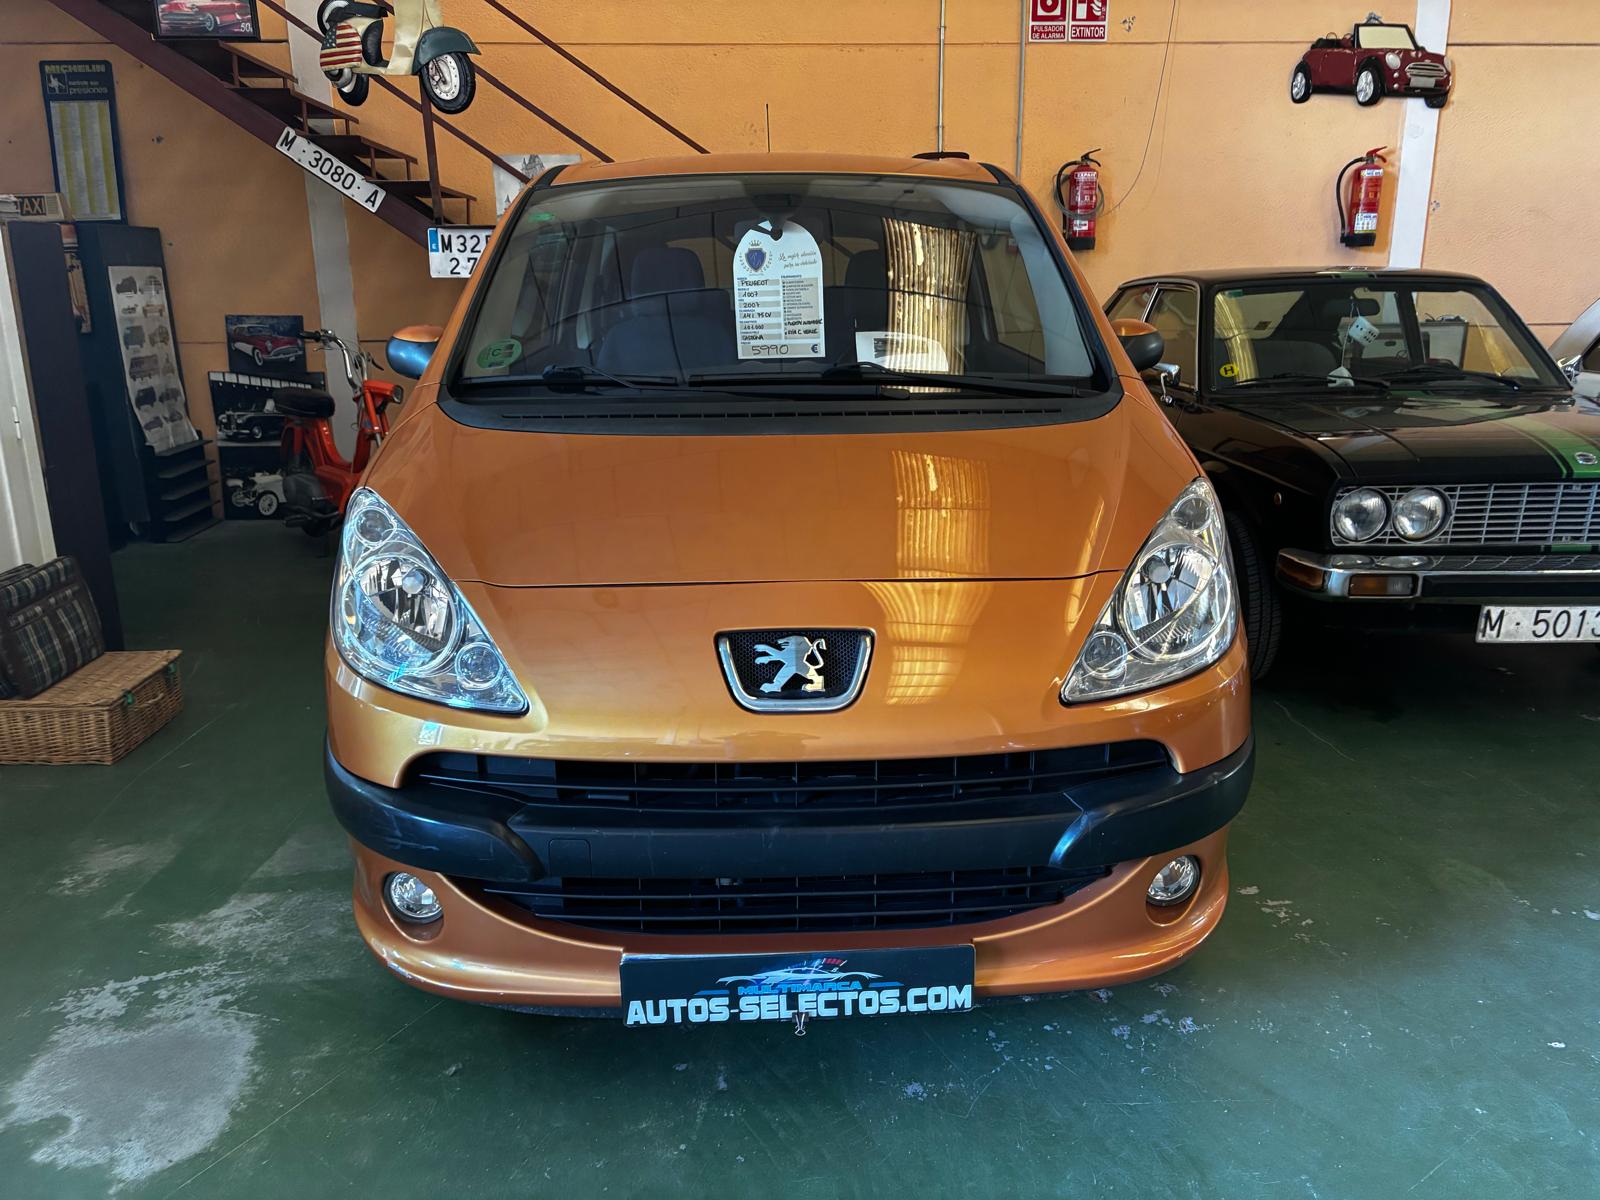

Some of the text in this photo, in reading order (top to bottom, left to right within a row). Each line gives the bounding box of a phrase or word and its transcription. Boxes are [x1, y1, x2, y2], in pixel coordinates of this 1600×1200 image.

[1071, 27, 1105, 38] EXTINTOR
[45, 64, 106, 73] MICHELIN
[308, 149, 356, 190] 3080
[752, 344, 818, 355] 5990 €
[1223, 366, 1235, 376] H
[1481, 609, 1506, 638] M
[738, 981, 863, 996] MULTIMARCA
[626, 984, 972, 1025] AUTOS-SELECTOS.COM
